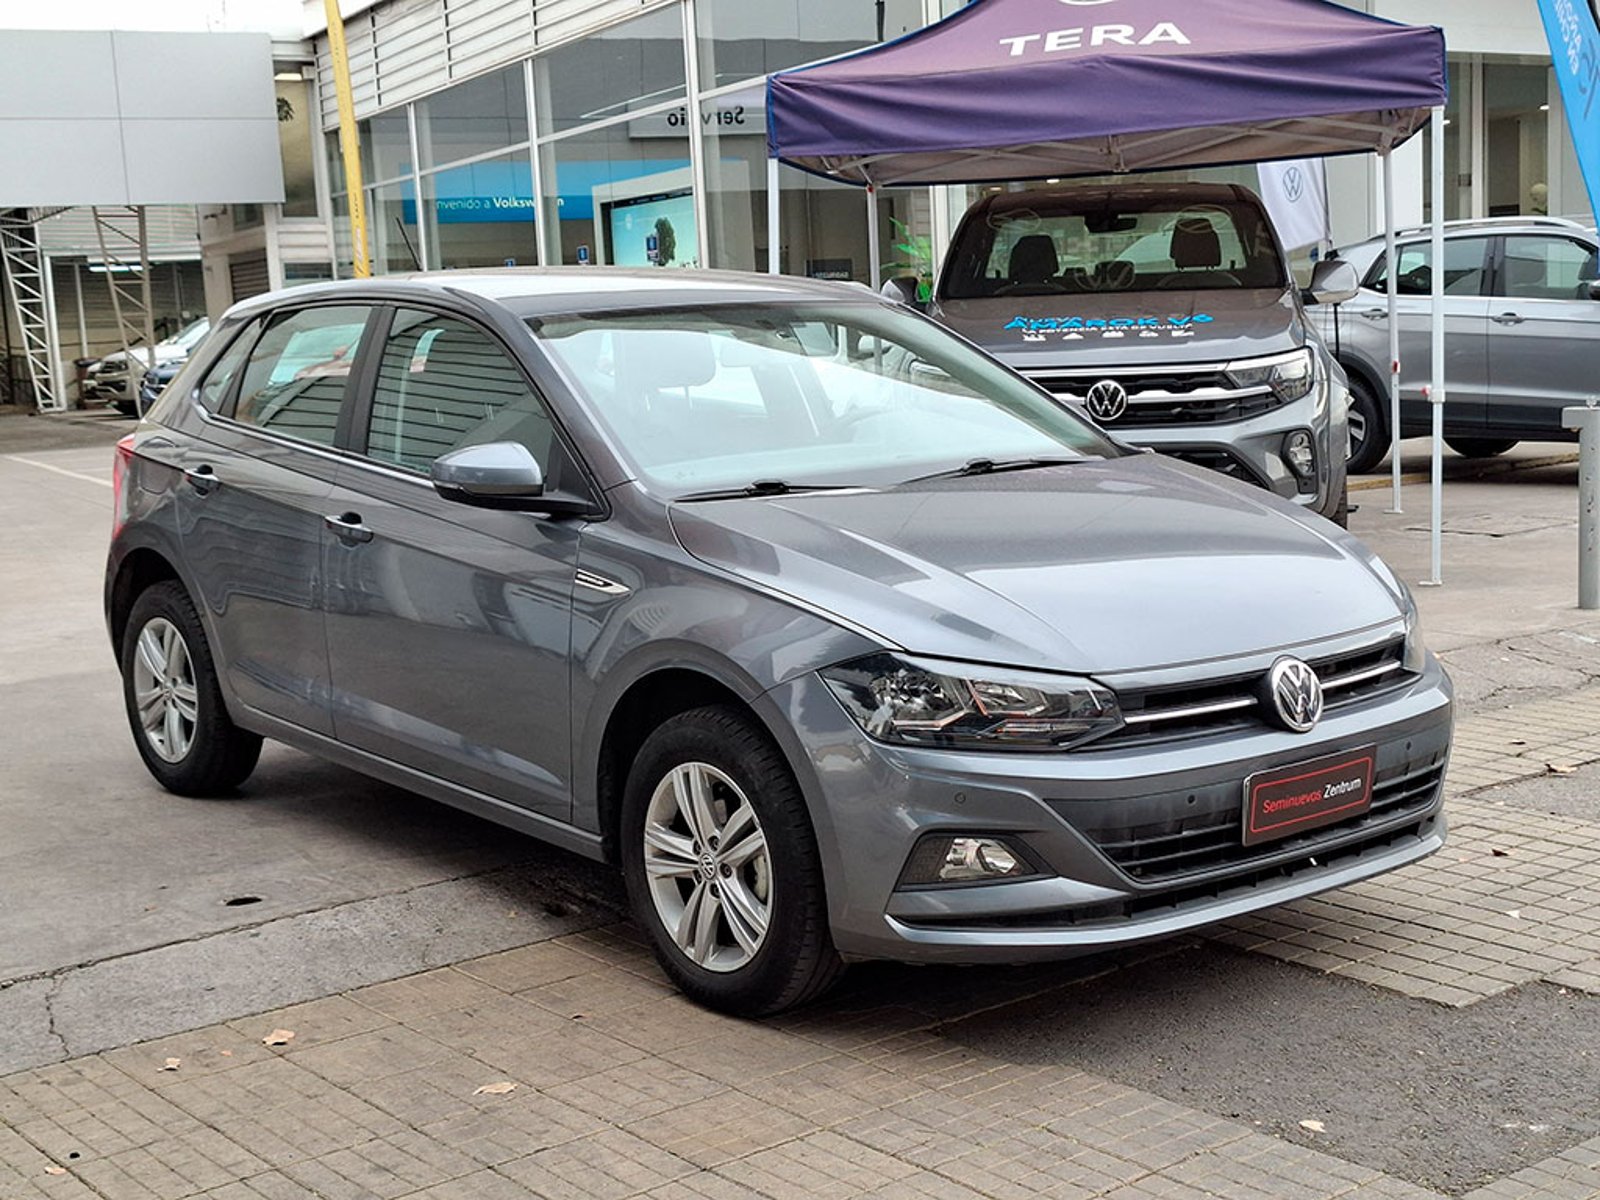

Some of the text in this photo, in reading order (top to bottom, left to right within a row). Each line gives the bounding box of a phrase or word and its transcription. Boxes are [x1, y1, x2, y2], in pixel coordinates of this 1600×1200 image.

[999, 22, 1191, 56] TERA
[436, 198, 480, 210] nvenido
[493, 197, 565, 209] Volkswn
[1262, 777, 1362, 814] Seminuevos Zentrum
